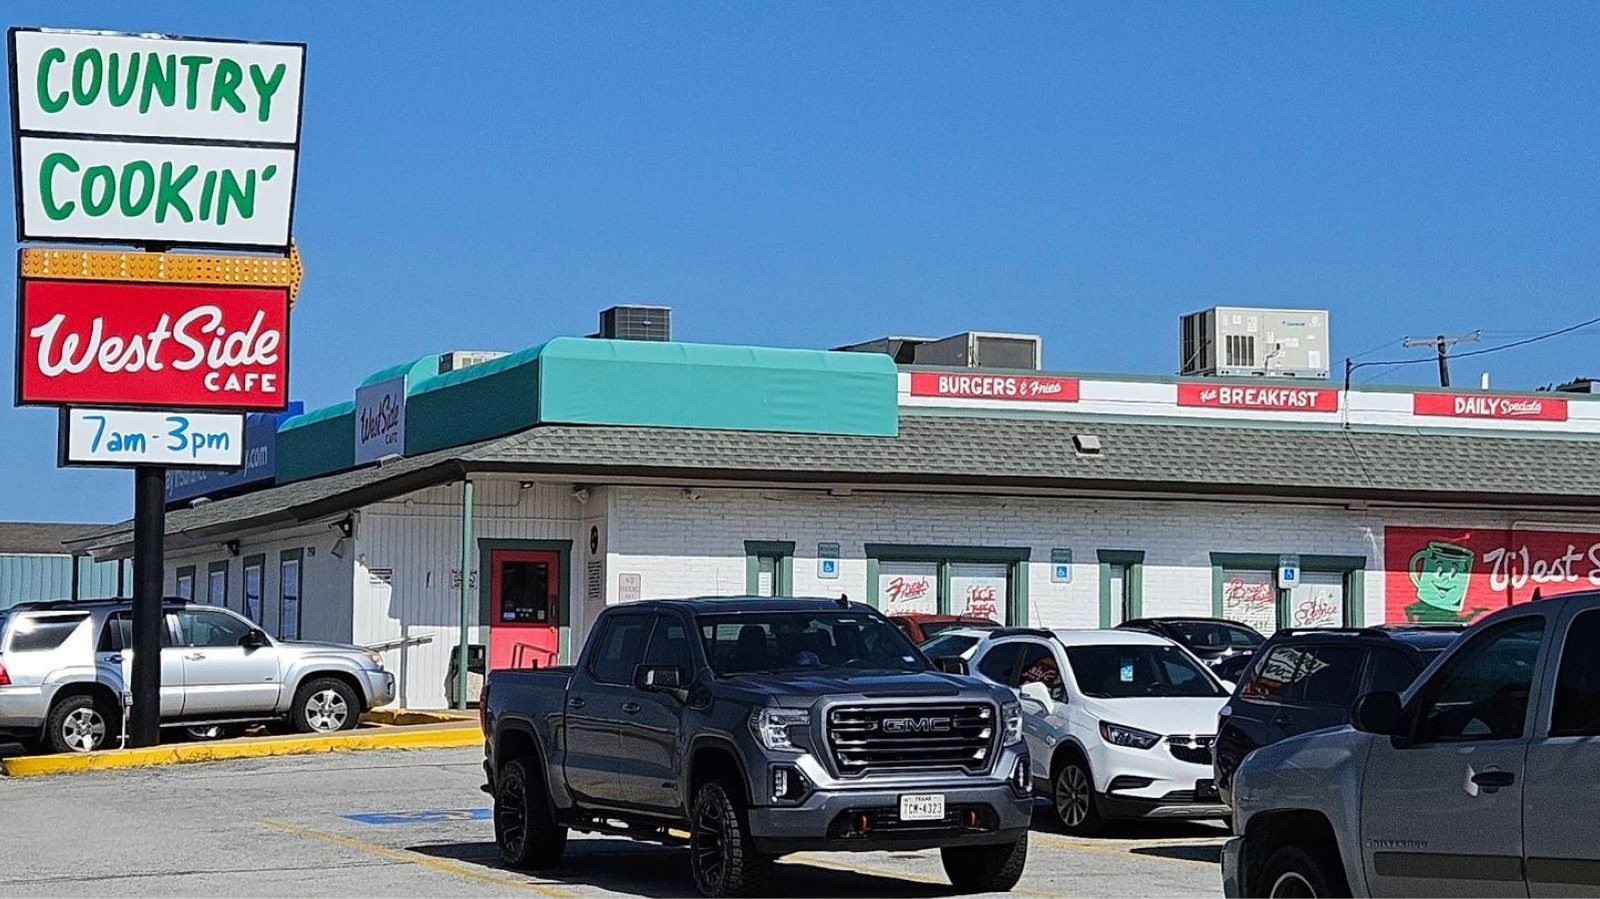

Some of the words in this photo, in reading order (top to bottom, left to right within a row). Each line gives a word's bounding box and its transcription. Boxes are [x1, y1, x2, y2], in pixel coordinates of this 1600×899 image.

[36, 47, 287, 123] COUNTRY
[38, 152, 278, 226] COOKIN'
[203, 371, 277, 393] CAFE
[938, 375, 1017, 396] BURGERS
[1019, 381, 1028, 395] &
[1030, 380, 1062, 396] Fries
[1199, 389, 1218, 403] Hot
[1219, 386, 1319, 408] BREAKFAST
[1454, 396, 1500, 415] DAILY
[1500, 399, 1542, 416] Specials
[82, 415, 147, 454] 7am
[165, 416, 230, 458] 3pm
[882, 717, 950, 733] GMC
